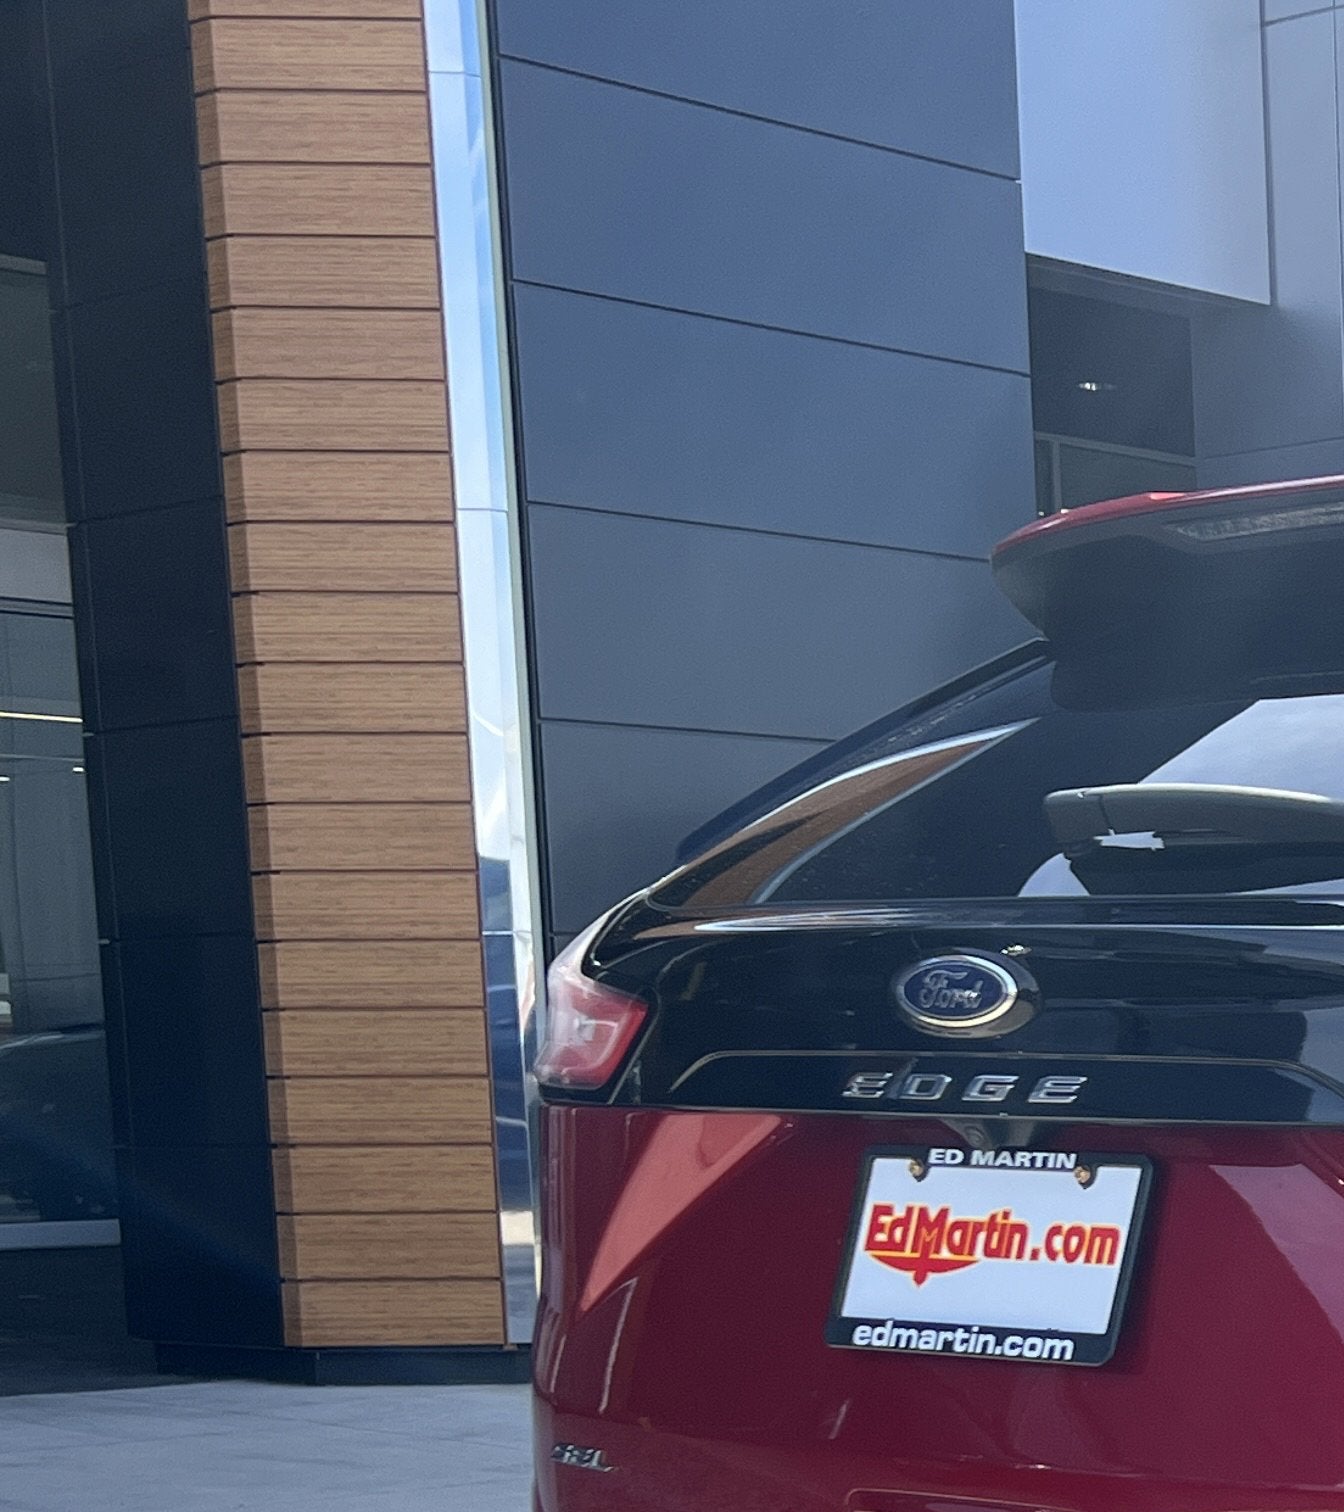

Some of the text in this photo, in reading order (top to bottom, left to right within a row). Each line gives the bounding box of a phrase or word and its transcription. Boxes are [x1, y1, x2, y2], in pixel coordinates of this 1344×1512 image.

[919, 969, 984, 1010] Ford
[842, 1070, 1089, 1104] EDGE
[928, 1148, 1078, 1170] ED MARTIN
[865, 1204, 1120, 1266] EdMartin.com
[853, 1320, 1075, 1361] edmartin.com
